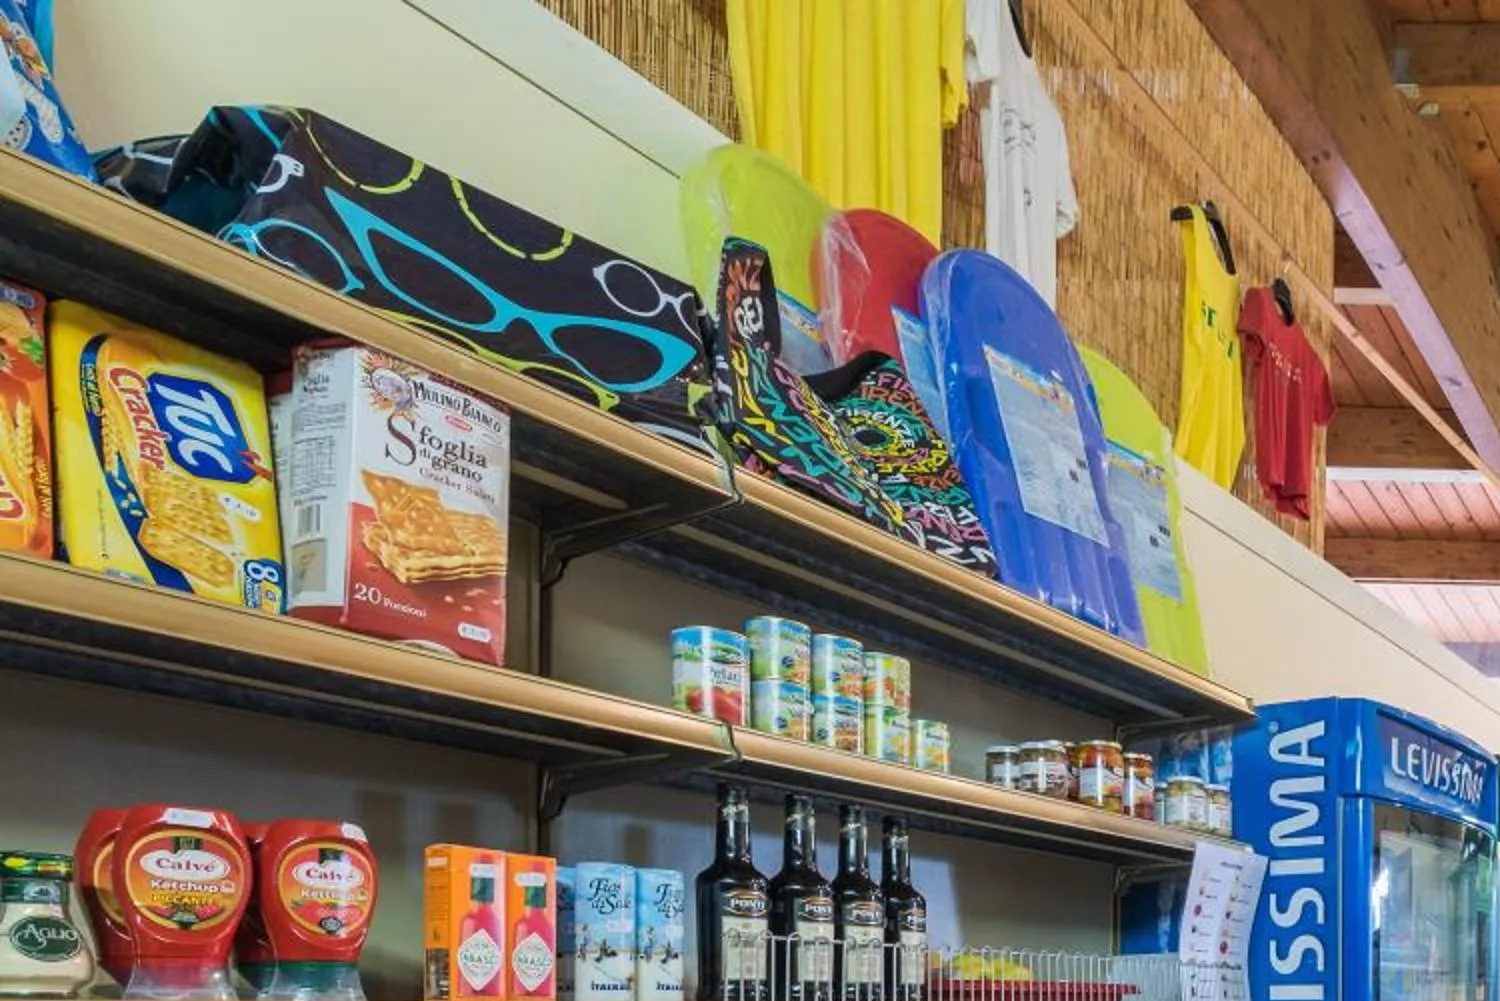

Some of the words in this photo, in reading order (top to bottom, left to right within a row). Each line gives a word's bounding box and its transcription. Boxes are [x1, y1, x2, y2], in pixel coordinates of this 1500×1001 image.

[108, 366, 170, 471] Cracker
[154, 382, 237, 474] TUC
[353, 582, 382, 606] 20
